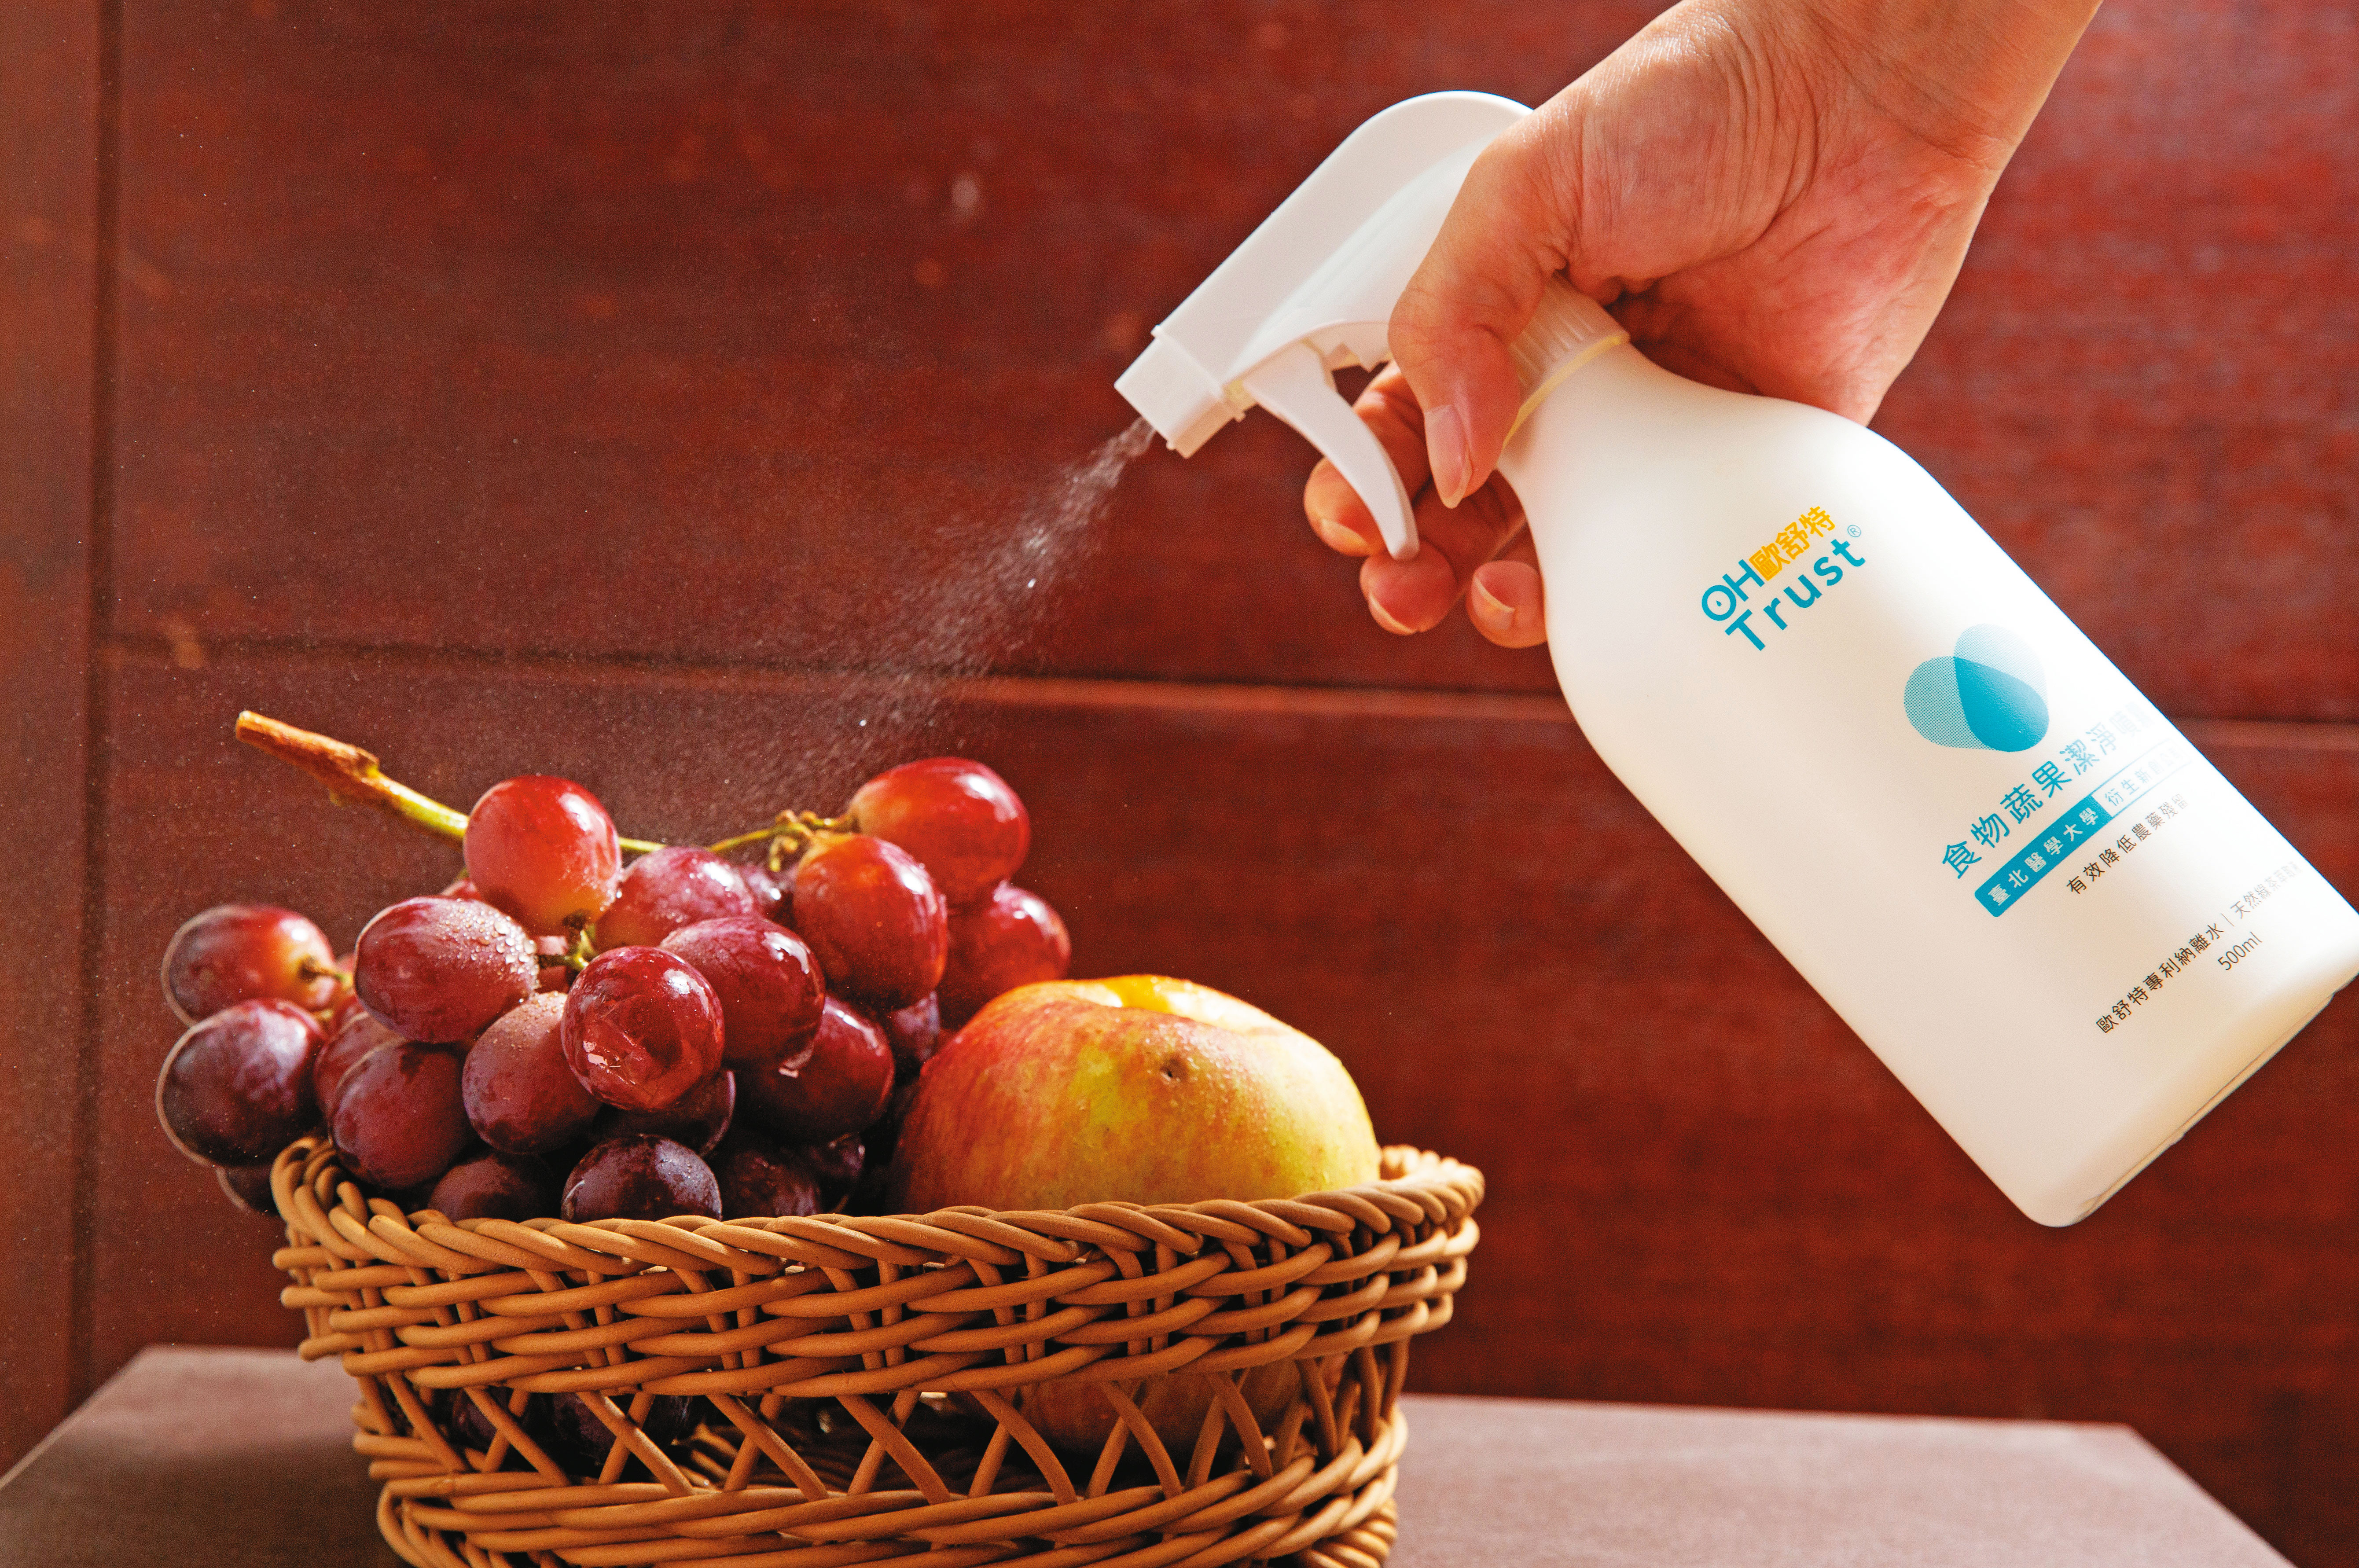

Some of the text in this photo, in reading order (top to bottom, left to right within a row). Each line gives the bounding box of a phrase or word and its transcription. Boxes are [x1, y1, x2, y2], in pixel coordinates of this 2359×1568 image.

[1701, 506, 1836, 621] OH 歐舒特
[1987, 806, 2100, 906] 臺北醫學大學
[2066, 793, 2189, 895] 有效降低農藥殘留
[2096, 923, 2224, 1034] 歐舒特專利納離水
[2217, 932, 2263, 971] 500ml
